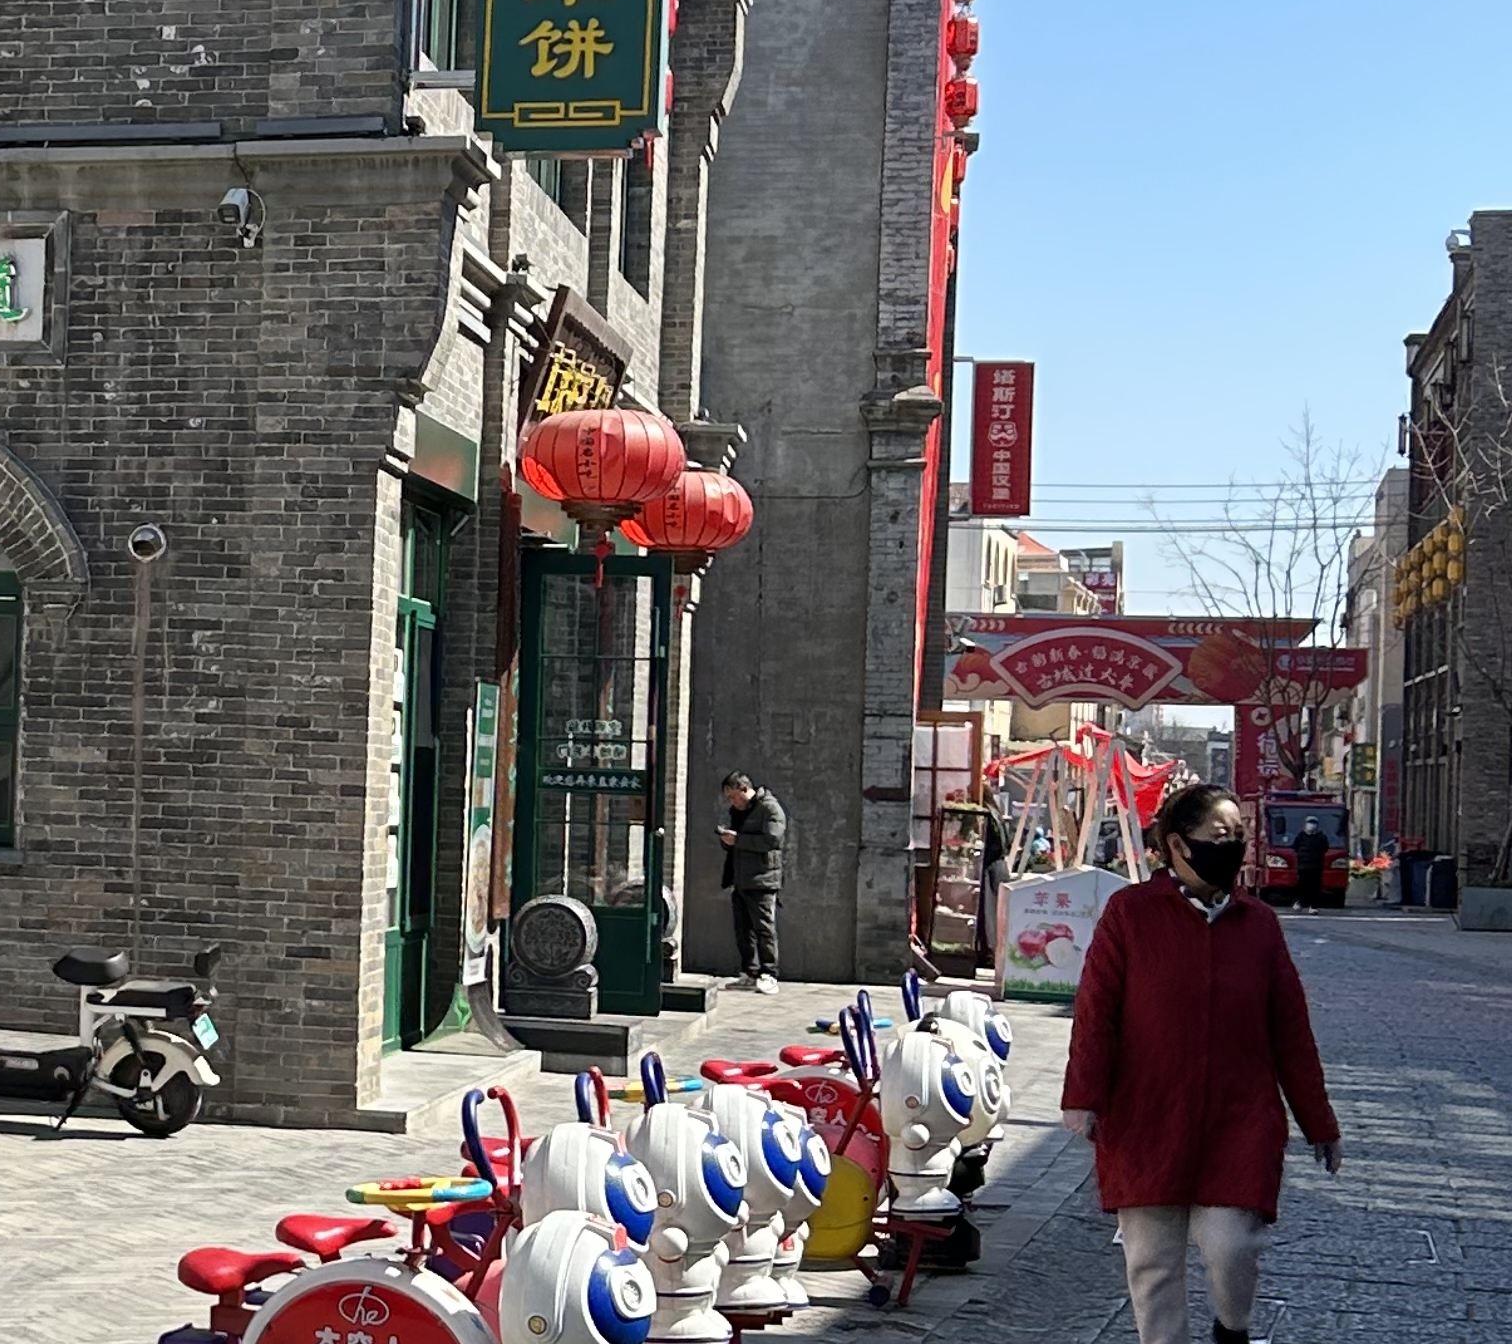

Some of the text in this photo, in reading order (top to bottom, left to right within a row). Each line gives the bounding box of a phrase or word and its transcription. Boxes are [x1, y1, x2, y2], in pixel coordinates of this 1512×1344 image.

[991, 369, 1017, 420] 塔斯汀
[991, 449, 1012, 500] 中国汉堡
[1033, 891, 1072, 908] 苹果
